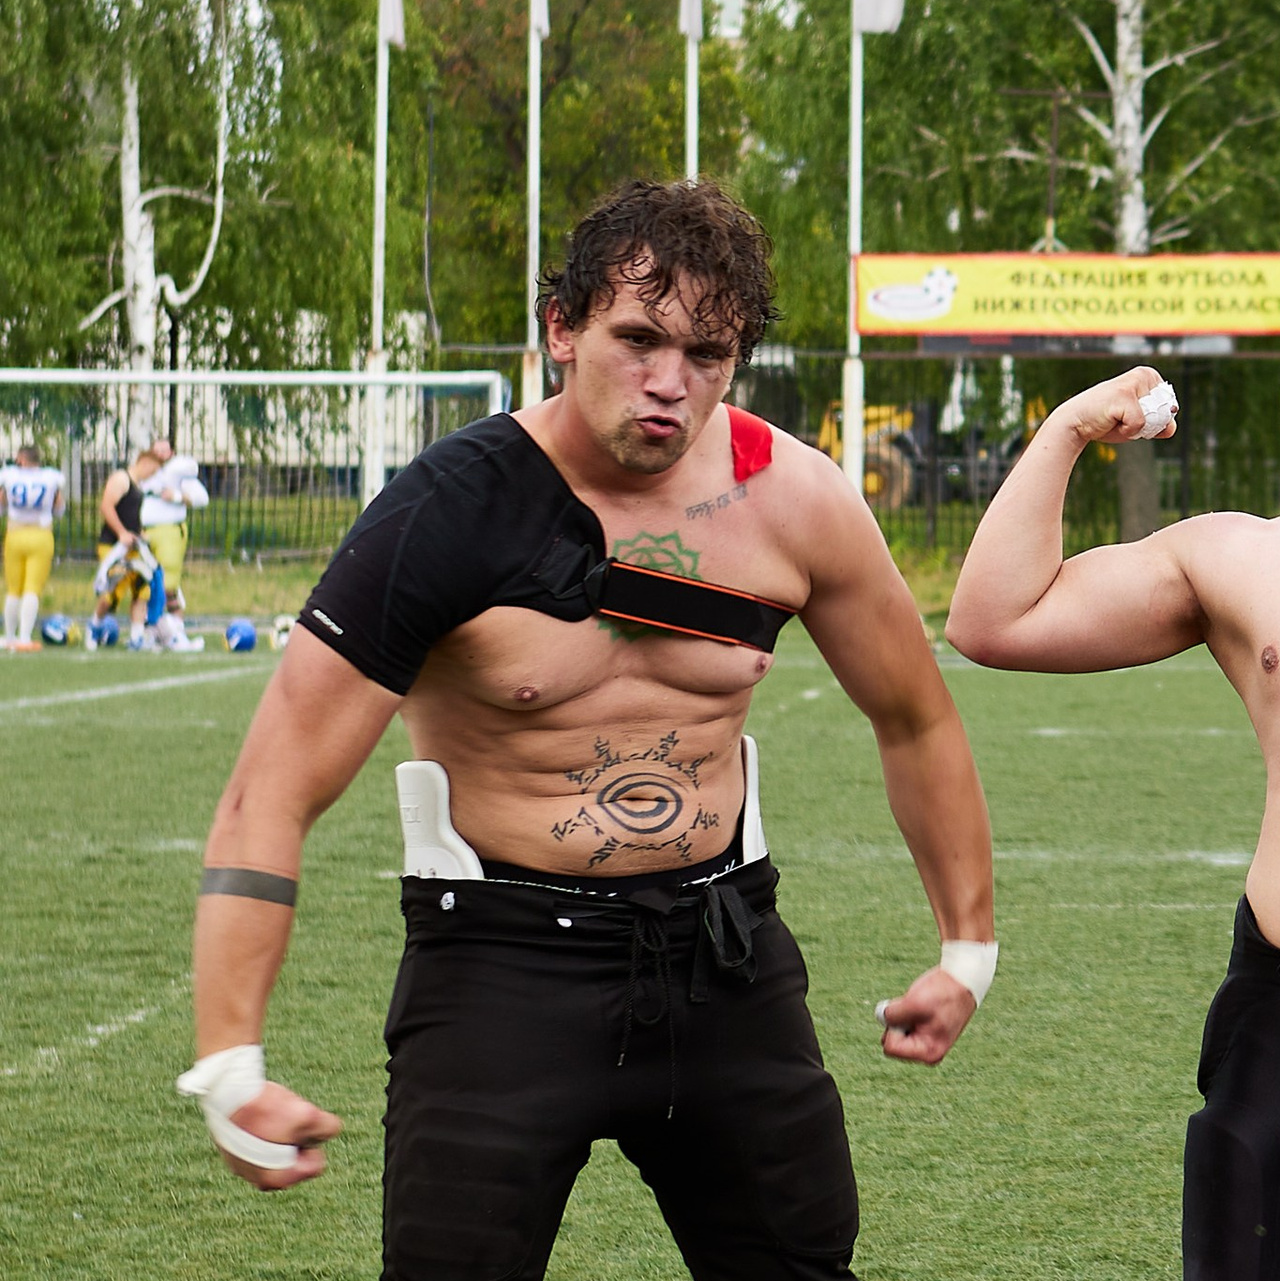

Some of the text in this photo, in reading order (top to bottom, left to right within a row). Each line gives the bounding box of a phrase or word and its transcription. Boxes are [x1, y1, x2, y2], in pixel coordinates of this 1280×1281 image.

[1008, 269, 1266, 289] ФЕДЕРАЦИЯ ФУТБОЛА
[973, 295, 1184, 316] НИЖЕГОРОДСКОЙ
[11, 483, 47, 509] 97
